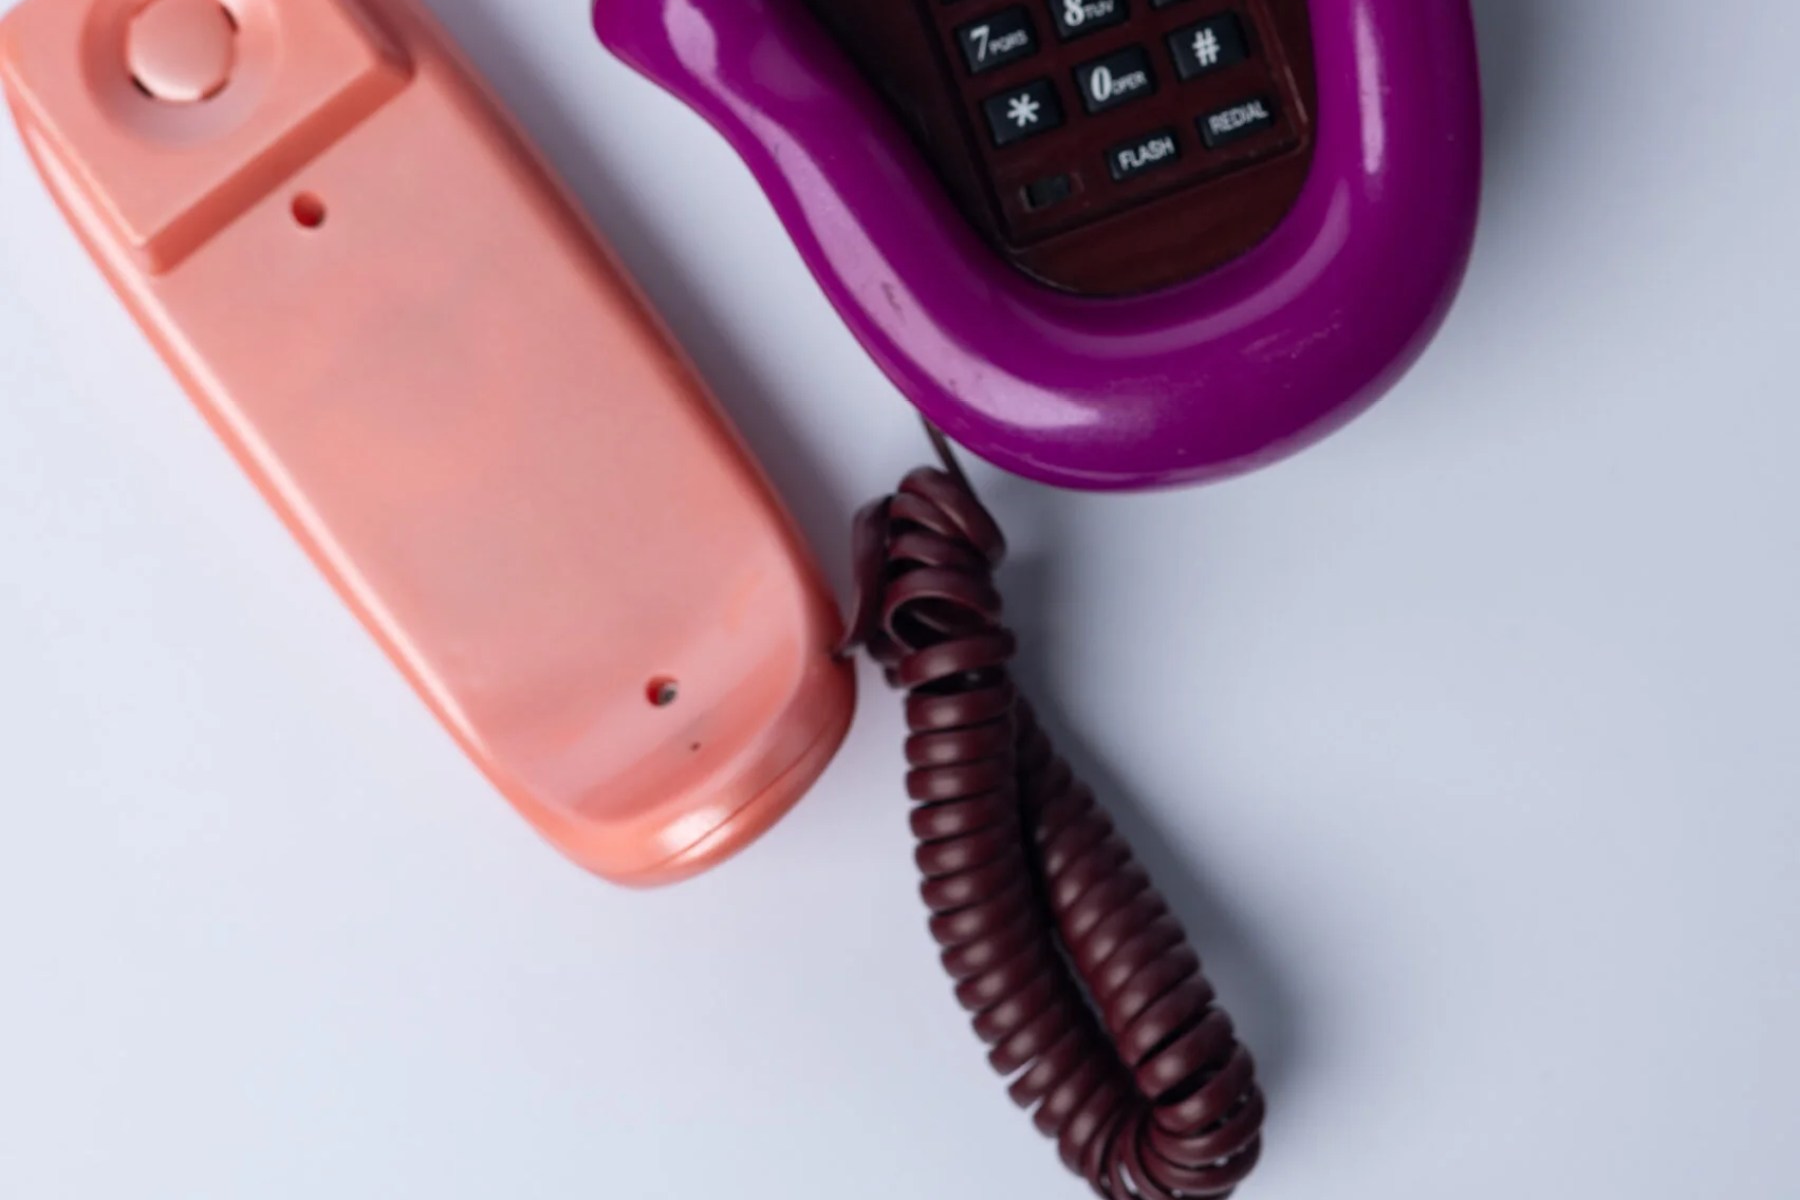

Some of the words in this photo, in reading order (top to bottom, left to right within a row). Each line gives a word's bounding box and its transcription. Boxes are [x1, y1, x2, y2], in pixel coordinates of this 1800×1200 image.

[970, 25, 990, 62] 7
[1192, 28, 1221, 66] #
[1090, 66, 1112, 101] 0
[1111, 71, 1148, 95] OPER
[1208, 100, 1269, 134] REDIAL
[1118, 137, 1176, 171] FLASH
